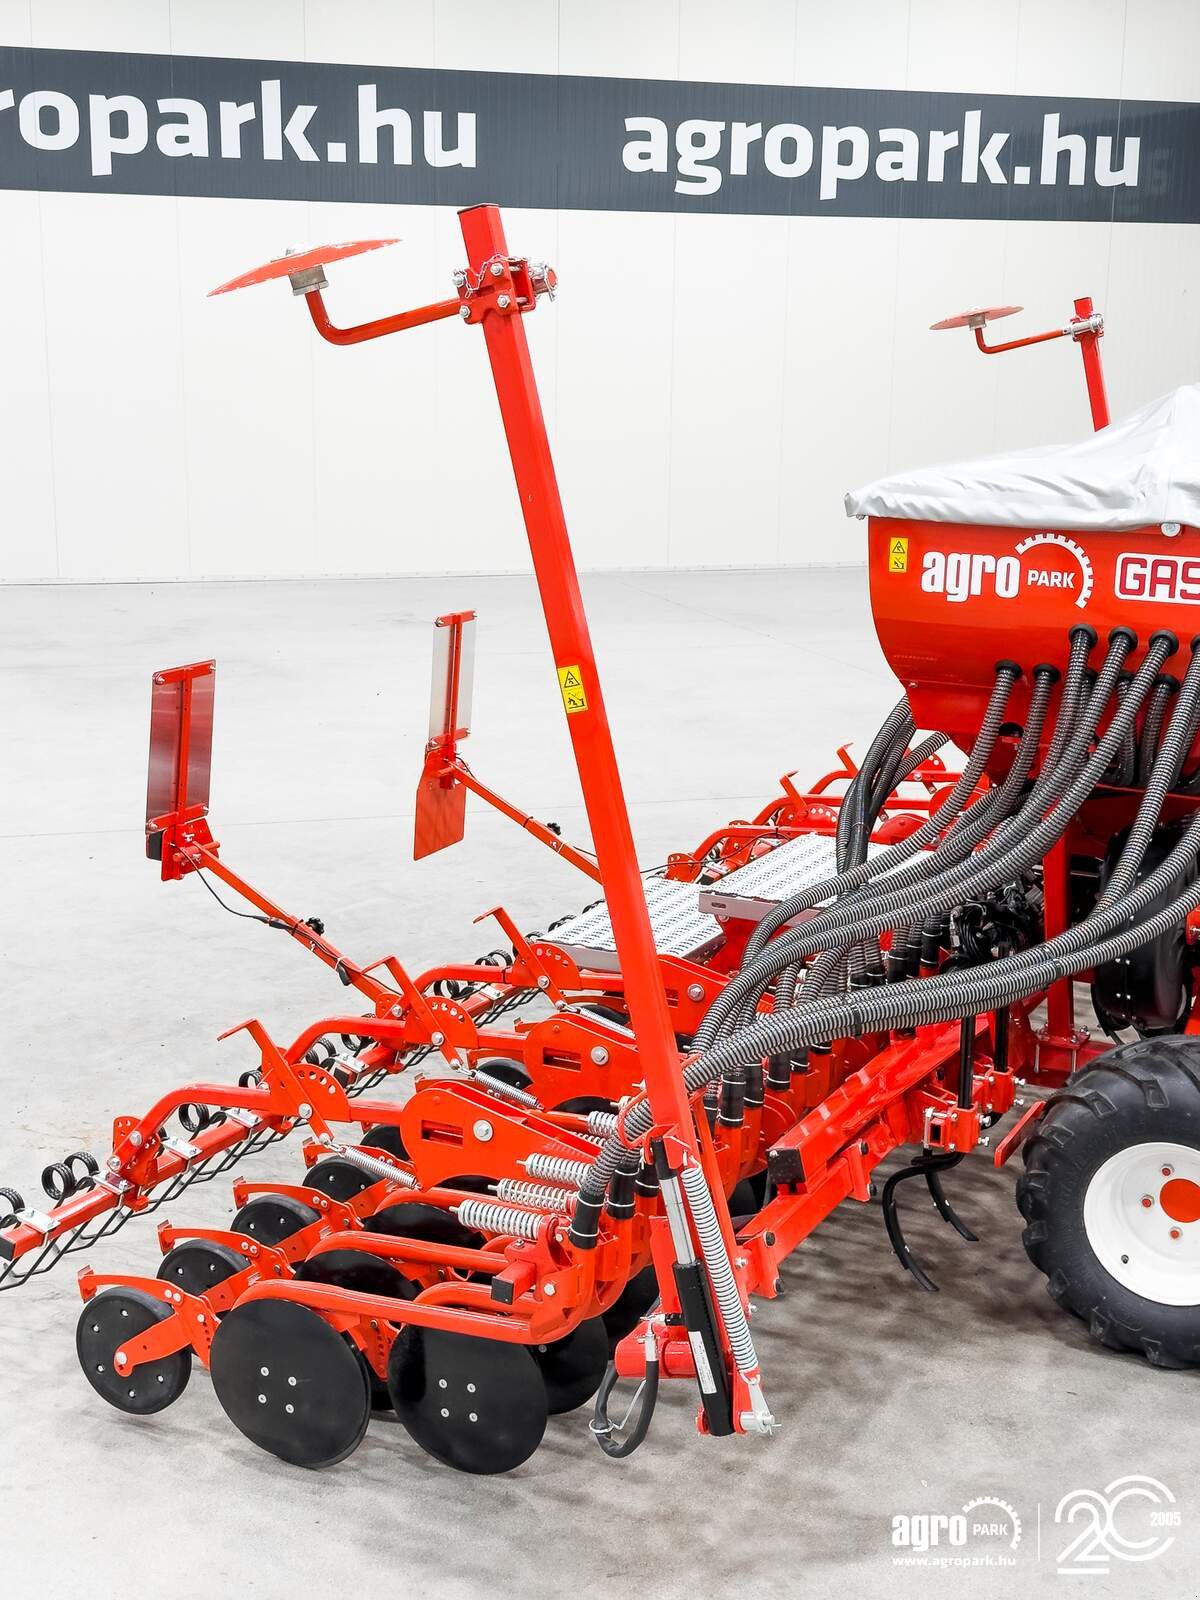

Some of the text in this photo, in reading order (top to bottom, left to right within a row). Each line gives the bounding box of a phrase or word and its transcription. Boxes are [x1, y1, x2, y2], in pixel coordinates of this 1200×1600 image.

[622, 110, 1141, 200] agropark.hu
[921, 551, 1076, 603] agro PARK
[1119, 557, 1200, 600] GAS
